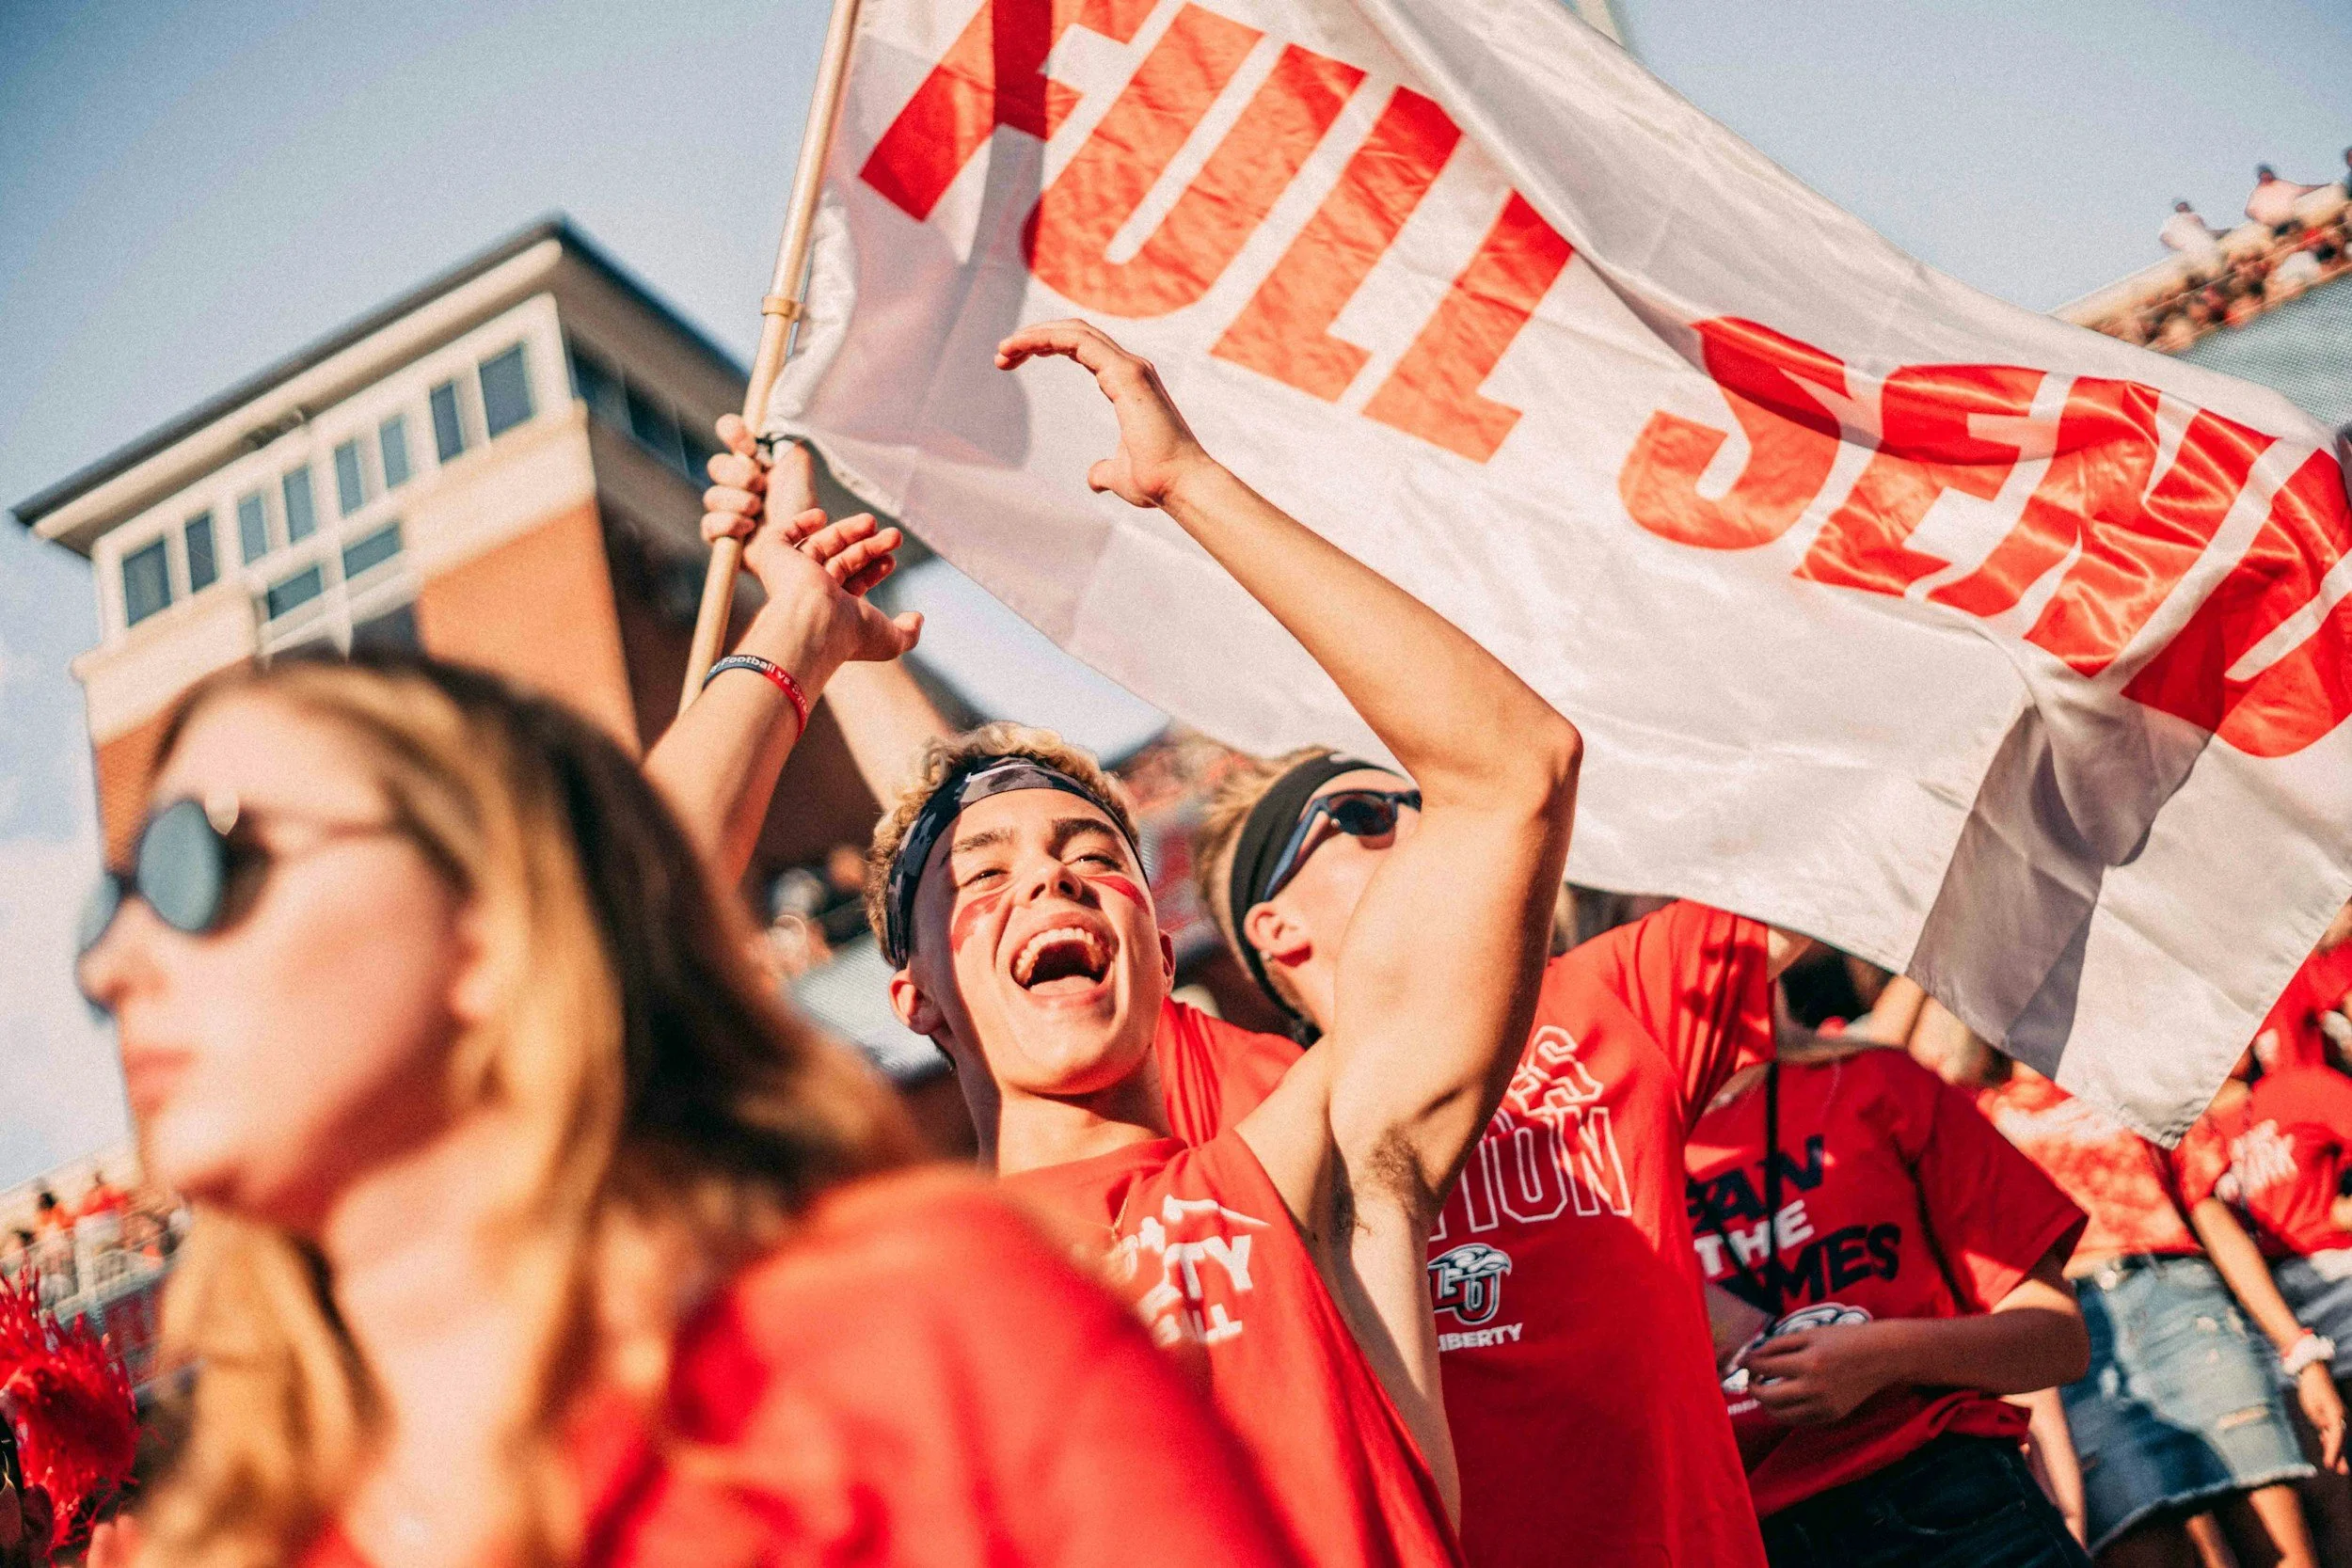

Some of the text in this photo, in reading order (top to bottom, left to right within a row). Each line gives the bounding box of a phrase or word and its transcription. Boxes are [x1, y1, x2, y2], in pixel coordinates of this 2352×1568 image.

[859, 0, 1573, 465] FULL
[1693, 1199, 1815, 1277] THE
[1438, 1323, 1523, 1352] IBERTY
